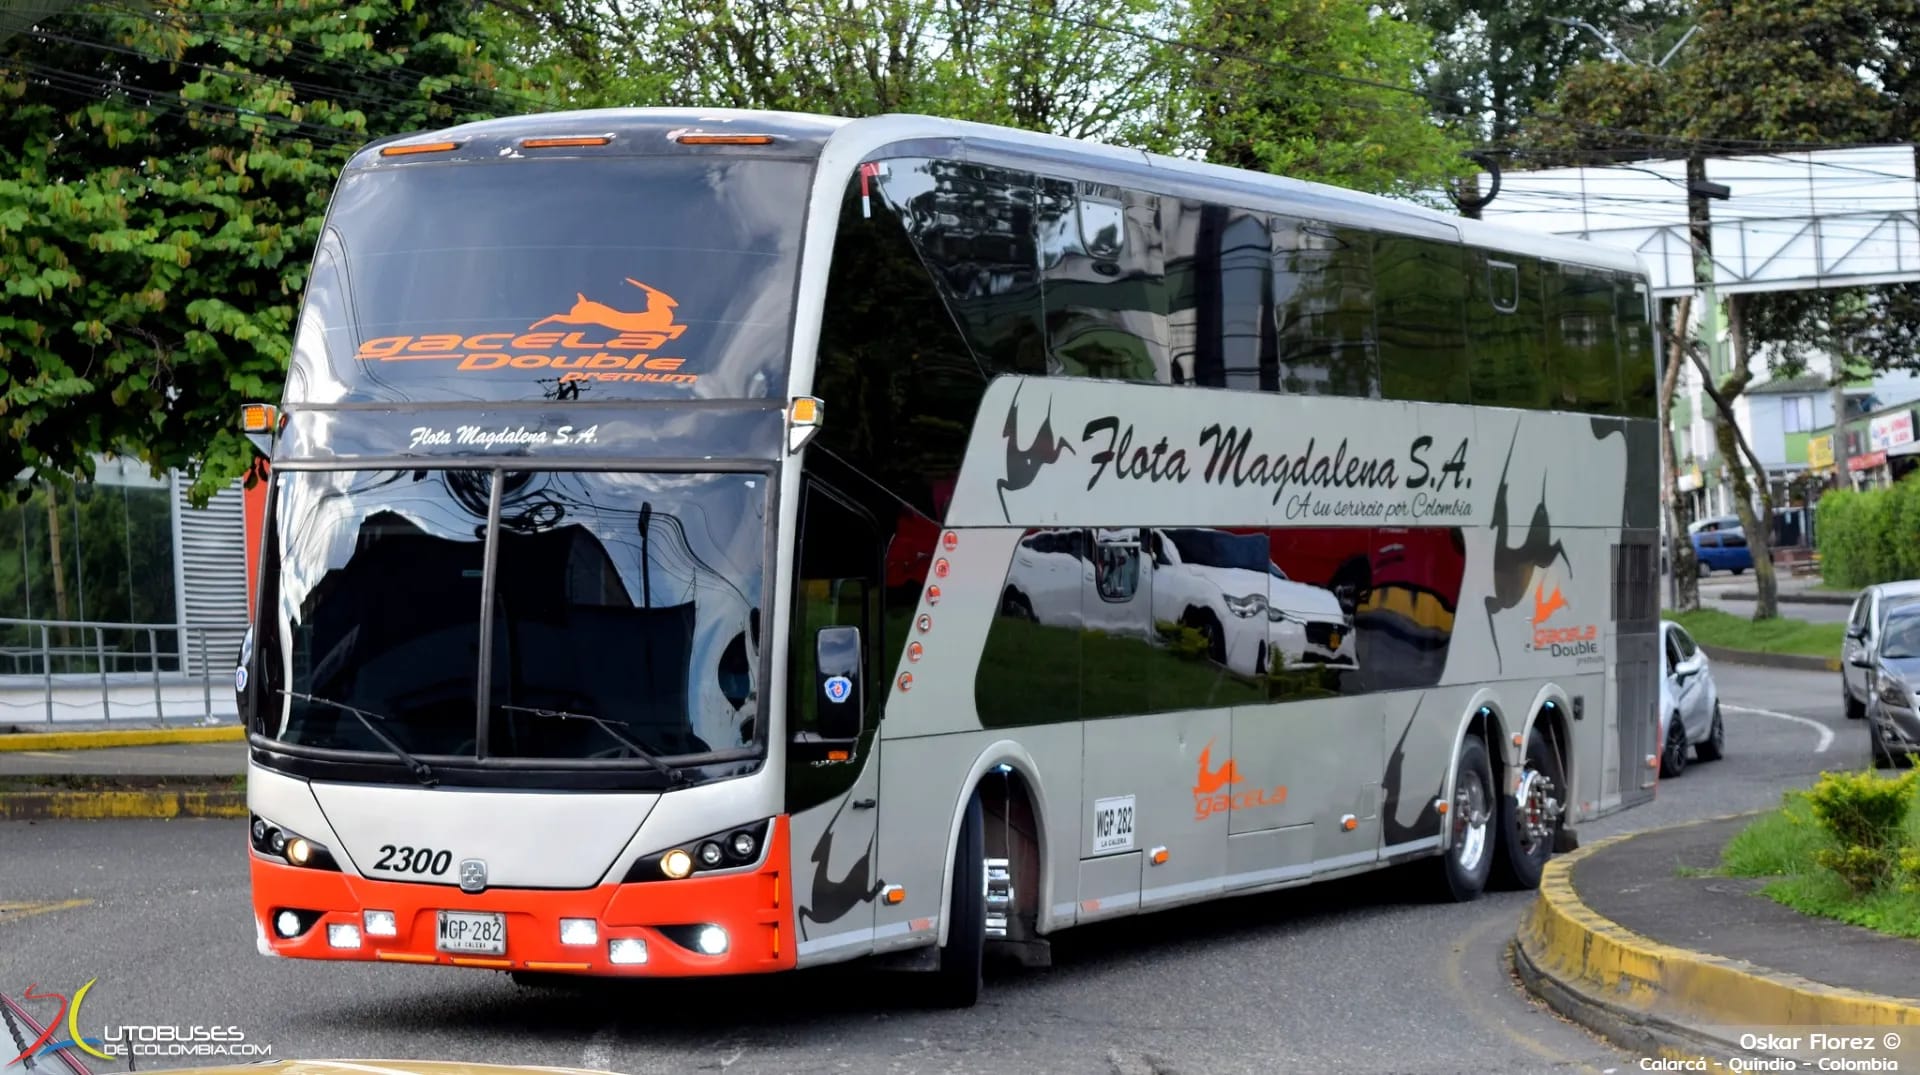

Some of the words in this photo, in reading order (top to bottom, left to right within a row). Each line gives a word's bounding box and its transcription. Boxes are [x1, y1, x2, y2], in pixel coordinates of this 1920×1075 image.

[457, 353, 686, 371] Double
[409, 427, 452, 449] Flota
[456, 425, 548, 450] Magdalena
[552, 425, 599, 444] S.A.
[1082, 415, 1190, 491] Flota
[1199, 423, 1399, 506] Magdalena
[1406, 435, 1472, 492] S.A.
[1312, 501, 1331, 517] su
[1384, 502, 1409, 522] por
[1411, 492, 1472, 518] Colombia
[1551, 641, 1598, 658] Double
[1097, 806, 1133, 837] WGP-282
[373, 844, 453, 876] 2300
[440, 919, 502, 942] WGP-282
